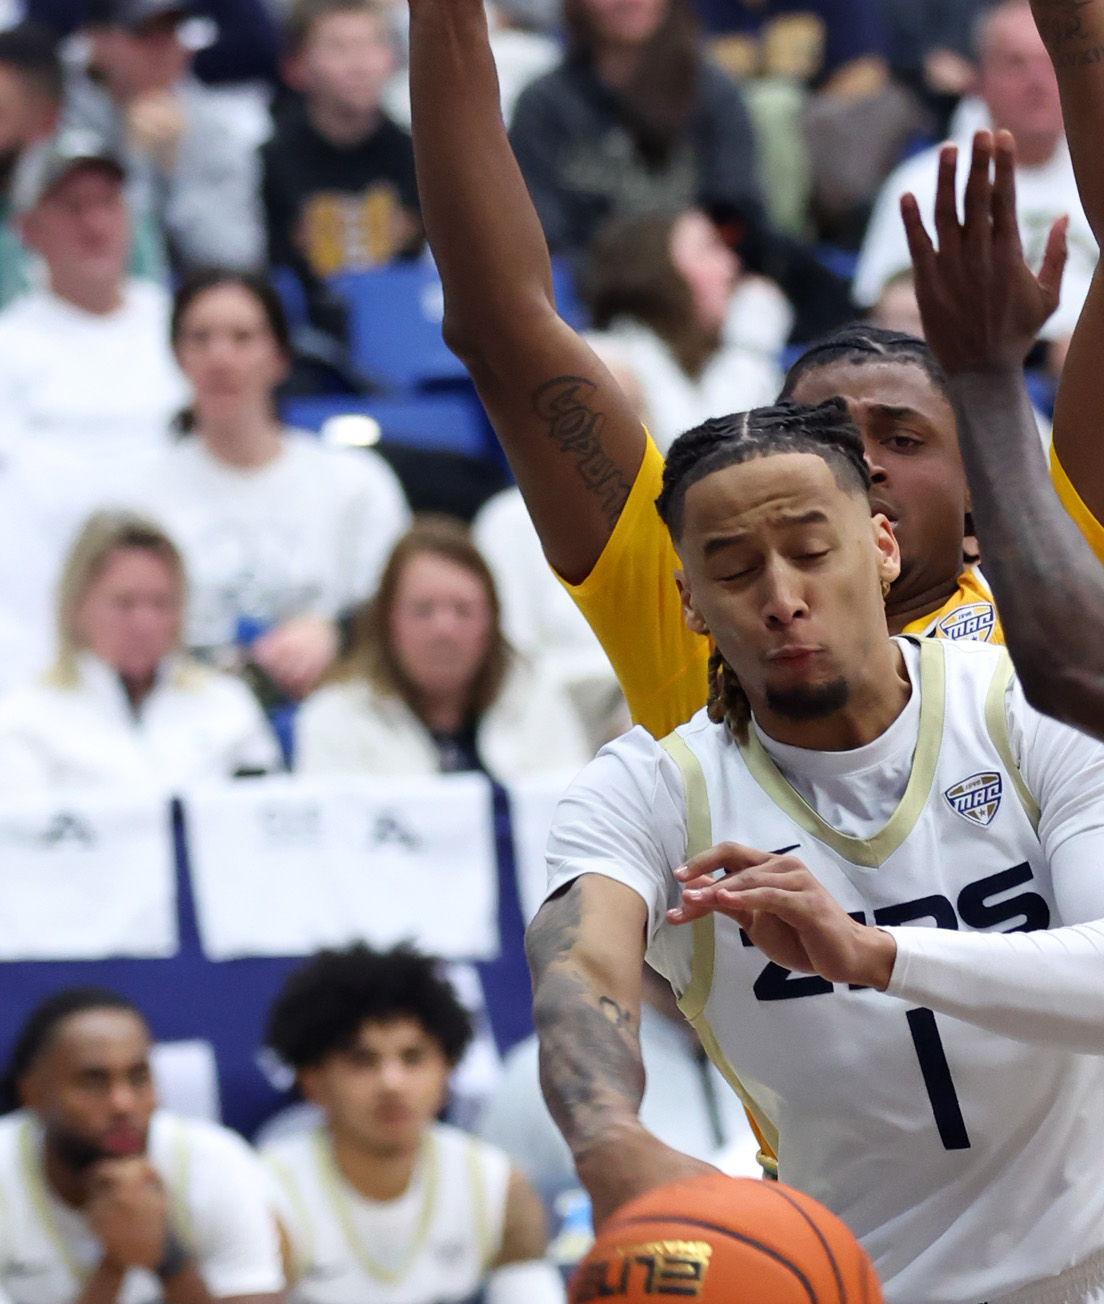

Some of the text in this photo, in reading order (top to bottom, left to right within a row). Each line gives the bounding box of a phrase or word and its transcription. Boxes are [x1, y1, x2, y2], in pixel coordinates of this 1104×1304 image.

[945, 611, 994, 640] MAC
[952, 783, 1002, 812] MAC
[905, 1006, 971, 1151] 1
